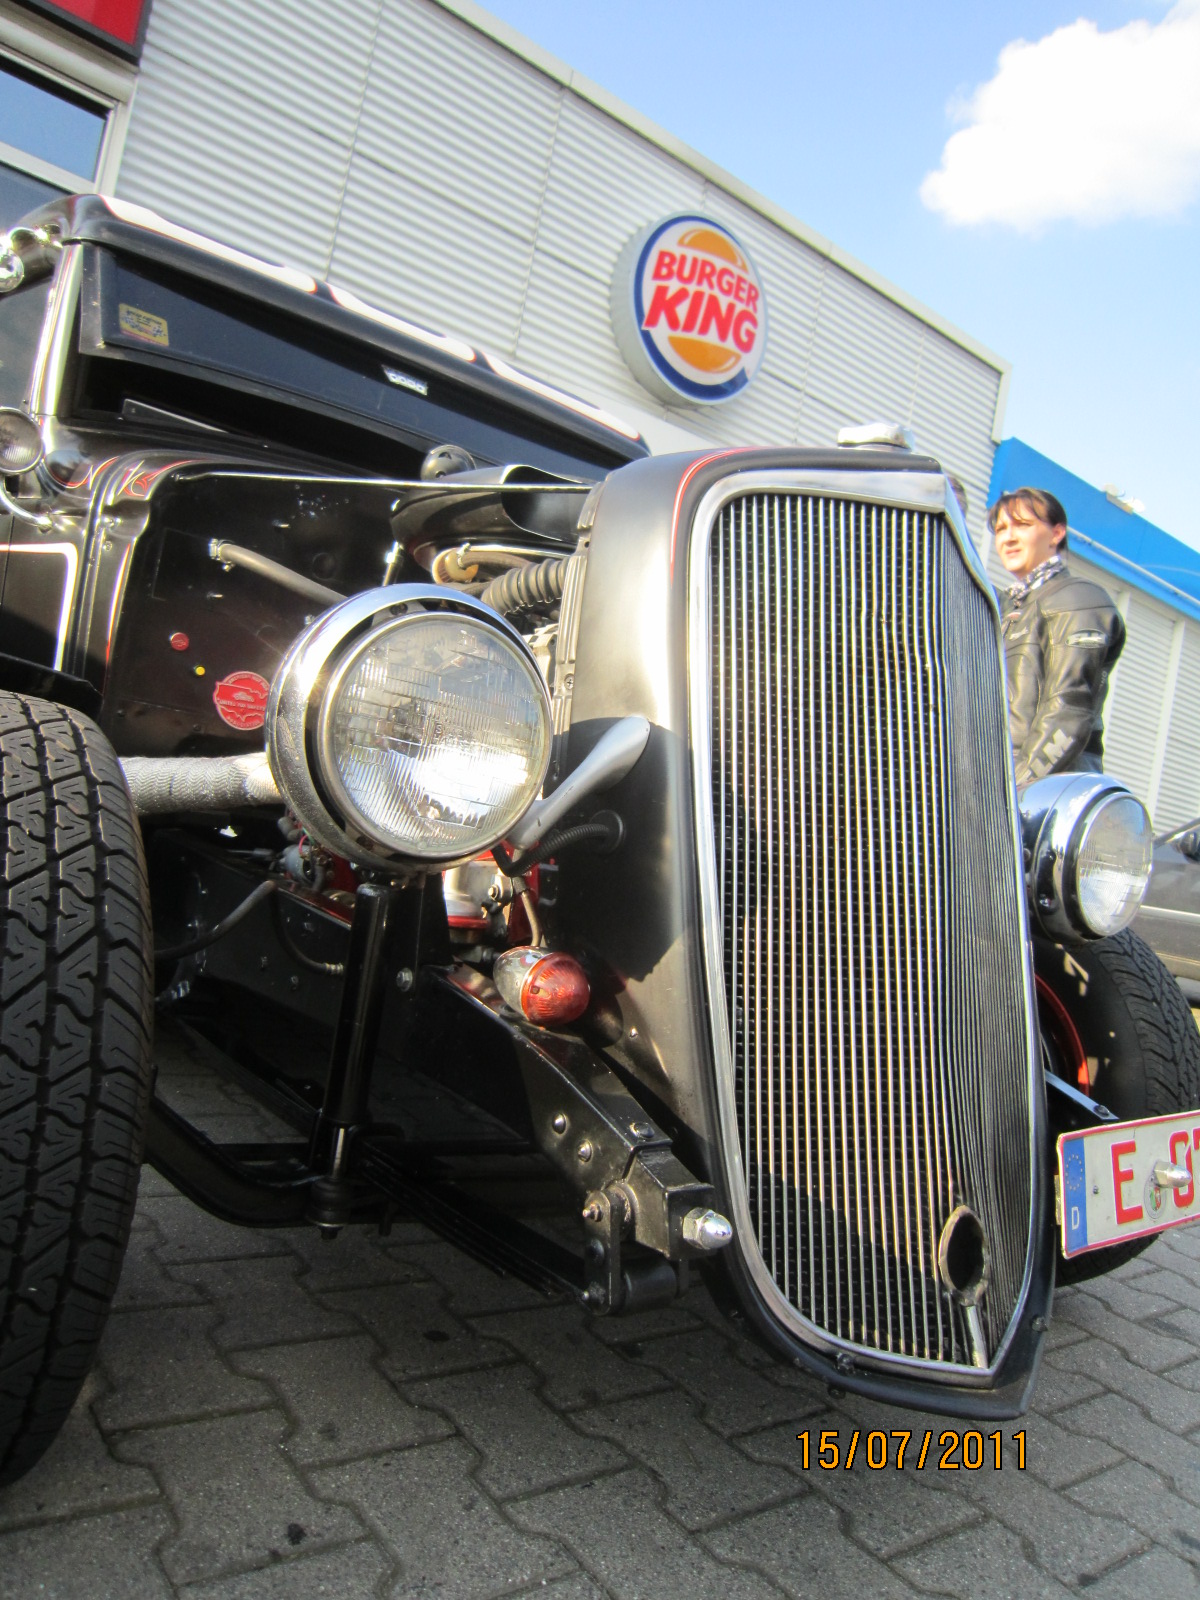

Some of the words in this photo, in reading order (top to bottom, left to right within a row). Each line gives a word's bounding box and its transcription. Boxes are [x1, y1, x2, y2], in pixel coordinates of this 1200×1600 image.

[652, 250, 759, 313] BURGER
[644, 285, 758, 353] KING
[1111, 1140, 1144, 1225] E
[1071, 1206, 1080, 1230] D
